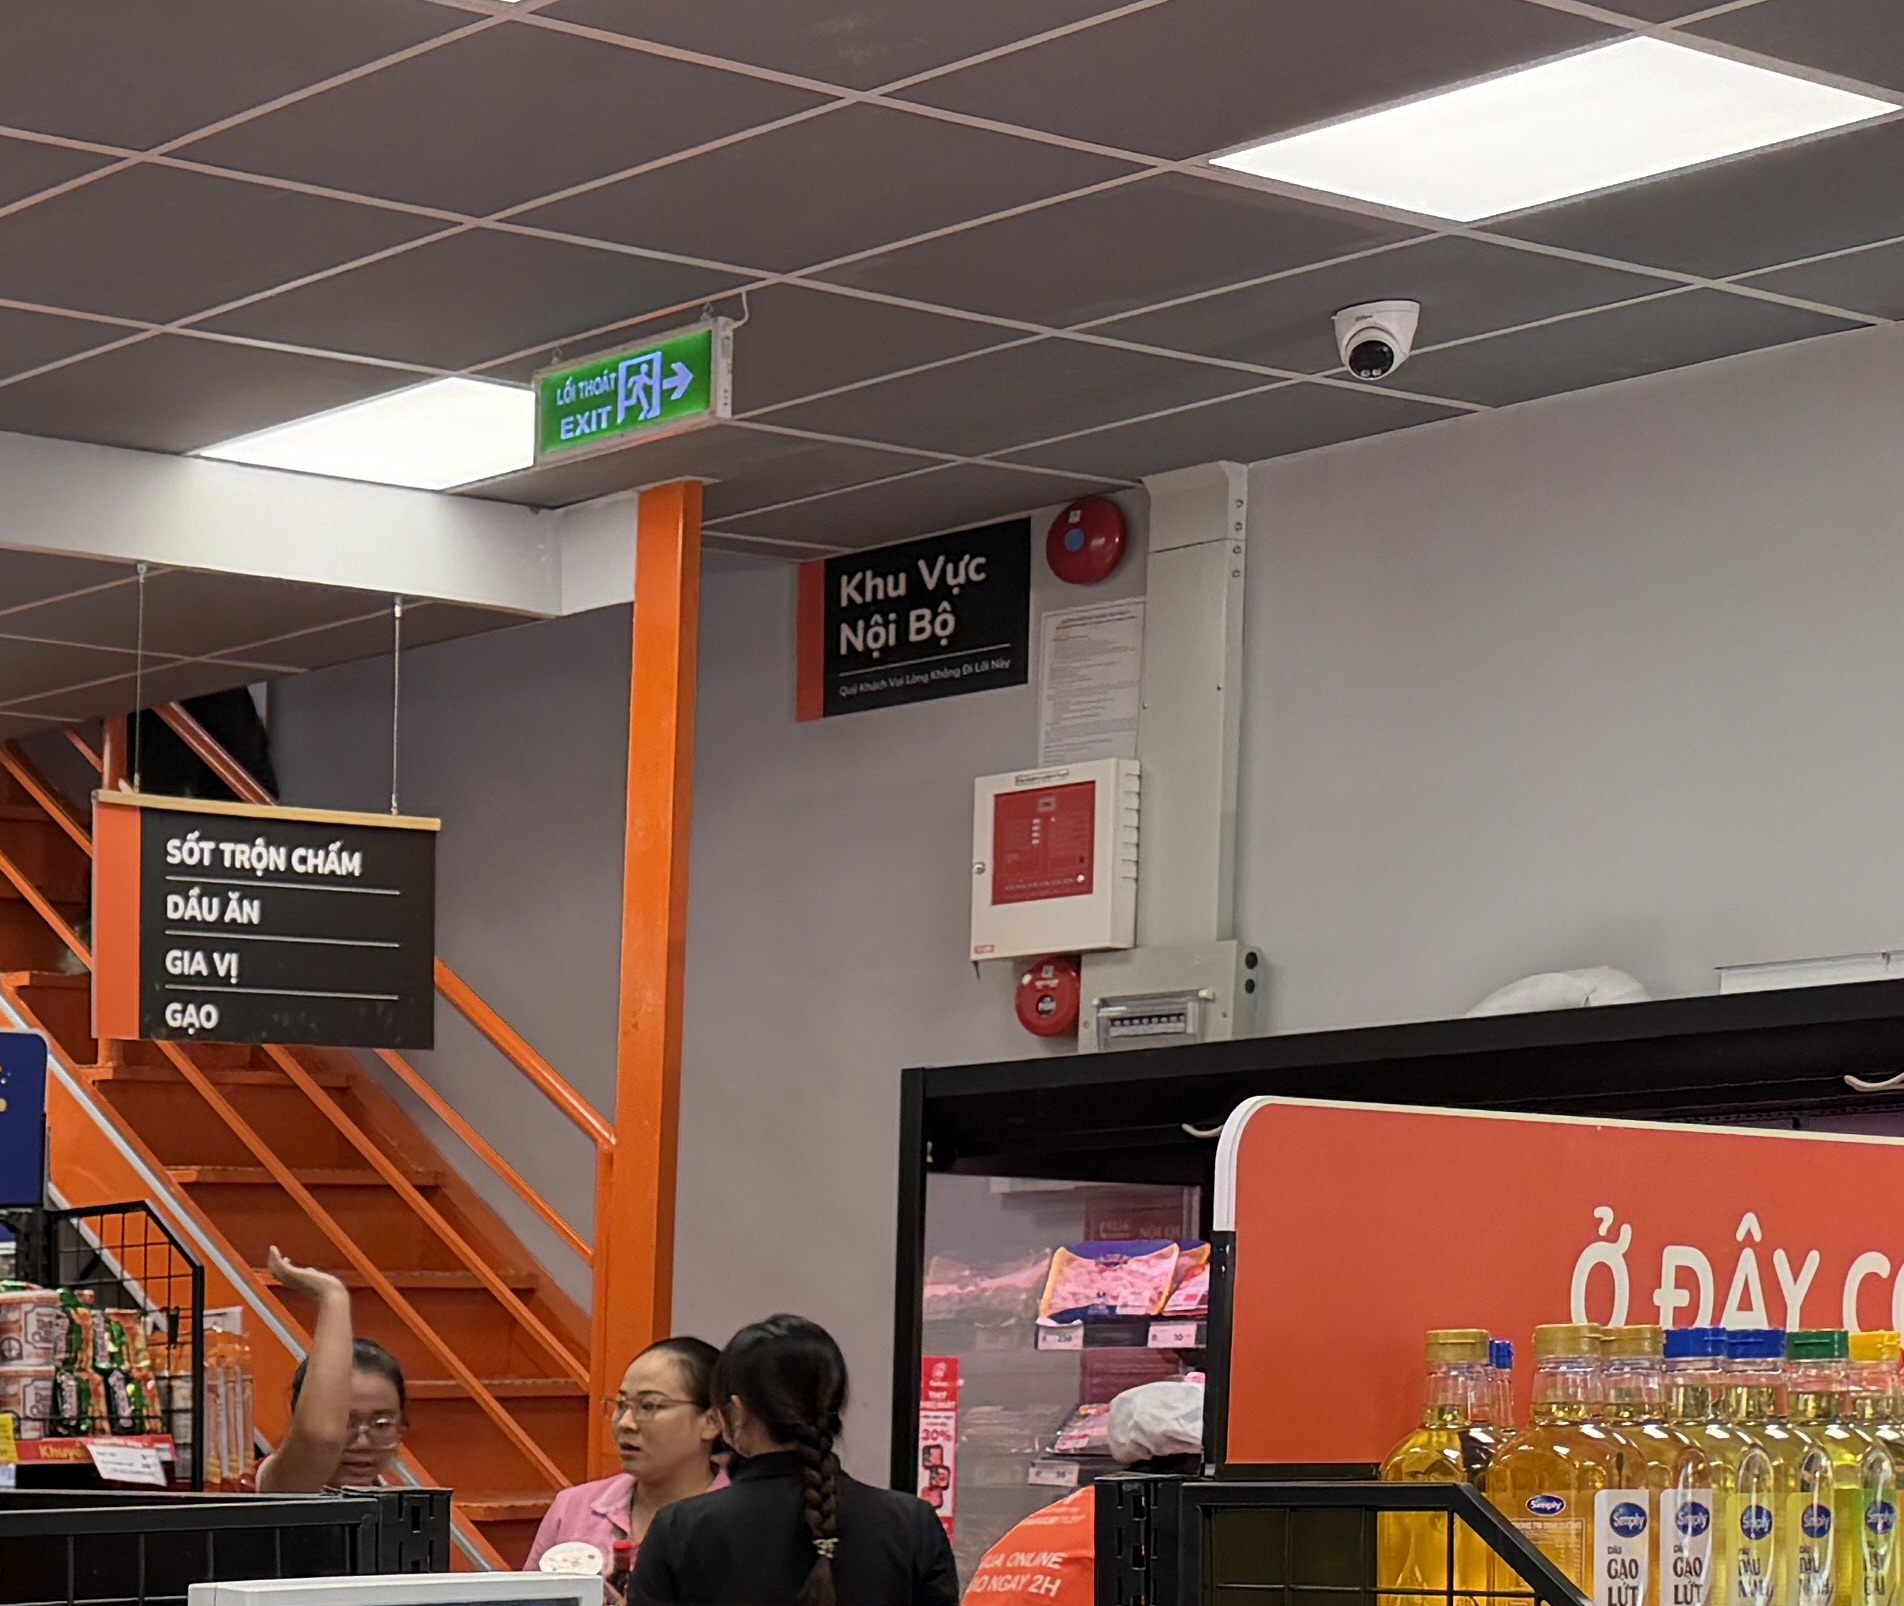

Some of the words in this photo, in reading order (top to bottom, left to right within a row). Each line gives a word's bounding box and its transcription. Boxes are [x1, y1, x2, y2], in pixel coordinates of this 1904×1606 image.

[578, 369, 617, 399] THOÁT
[561, 406, 612, 440] EXIT
[840, 569, 906, 608] Khu
[918, 553, 987, 595] Vực
[840, 613, 897, 659] Nội
[909, 601, 955, 645] Bộ
[166, 831, 214, 866] SỐT
[219, 838, 286, 876] TRỘN
[292, 841, 361, 876] CHẤM
[166, 887, 219, 922] DẦU
[224, 891, 260, 924] ĂN
[165, 950, 207, 976] GIA
[214, 953, 239, 984] VỊ
[165, 1003, 218, 1034] GẠO
[1653, 1210, 1821, 1330] ĐÂY
[1843, 1250, 1904, 1331] C
[921, 1428, 952, 1442] 30%
[1612, 1510, 1644, 1530] Simply
[1607, 1558, 1639, 1582] GẠO
[1672, 1557, 1703, 1580] GẠO
